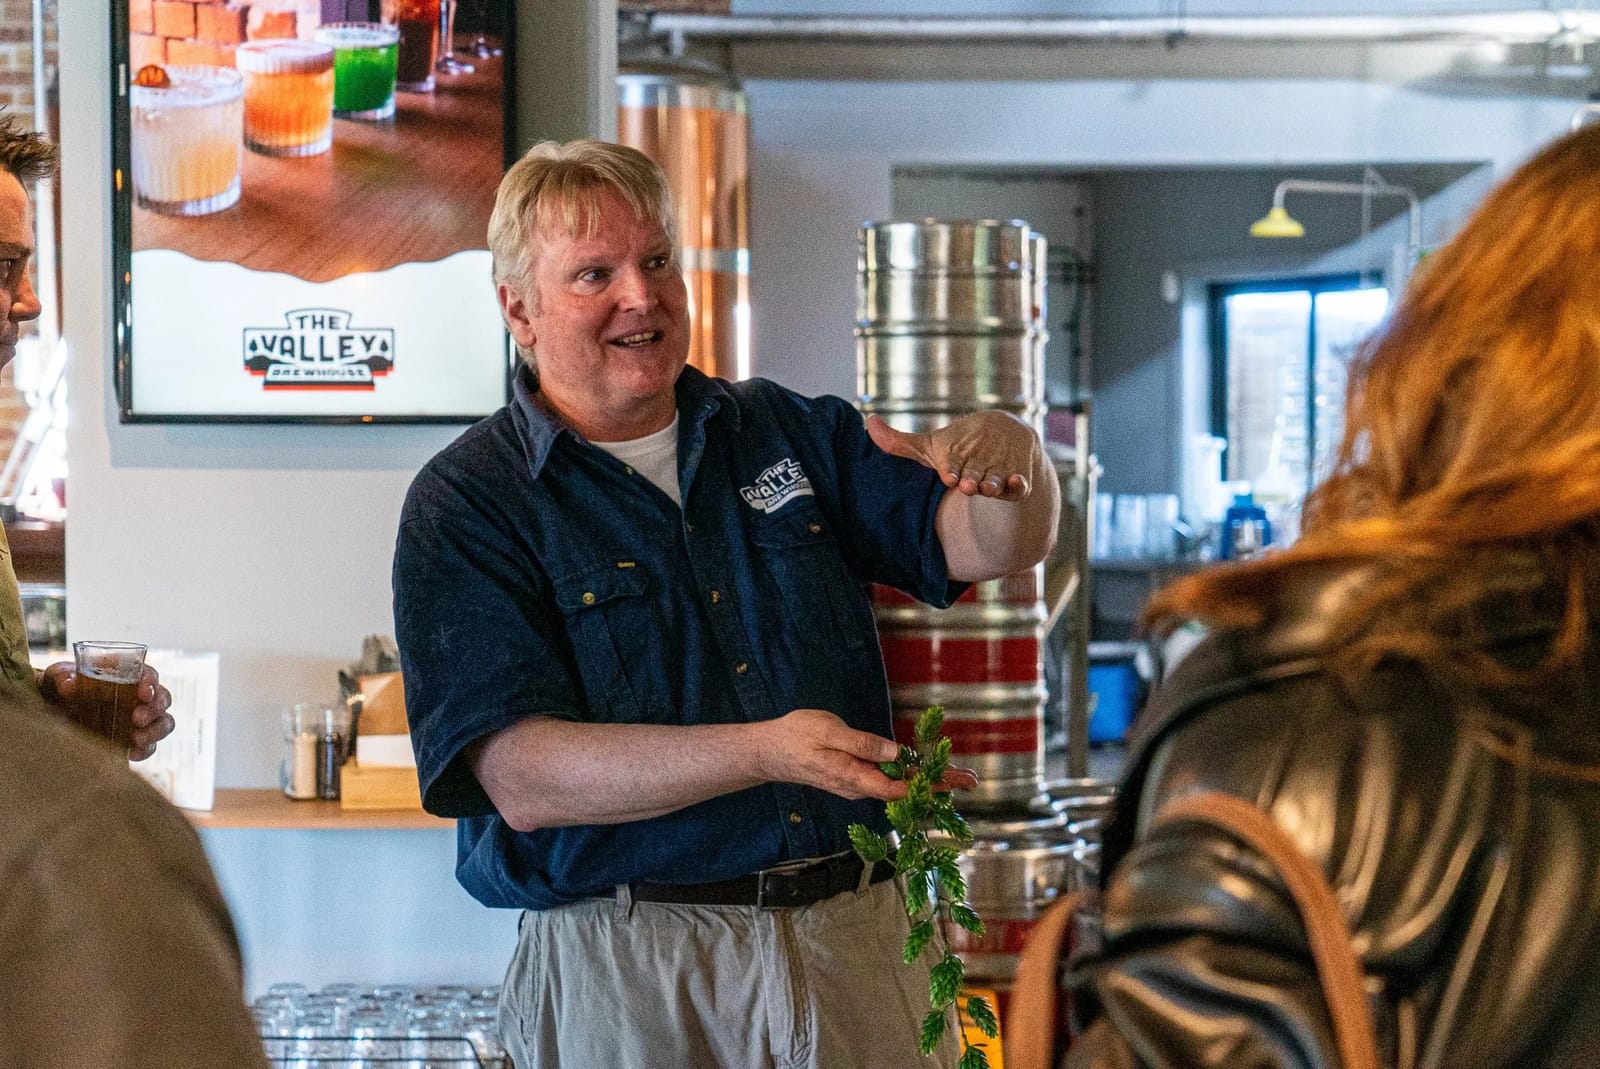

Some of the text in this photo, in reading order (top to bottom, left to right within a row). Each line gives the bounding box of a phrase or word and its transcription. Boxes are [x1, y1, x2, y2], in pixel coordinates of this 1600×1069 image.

[296, 314, 340, 330] THE
[261, 335, 376, 362] VALLEY
[750, 467, 802, 498] VALLE
[761, 464, 788, 482] THE
